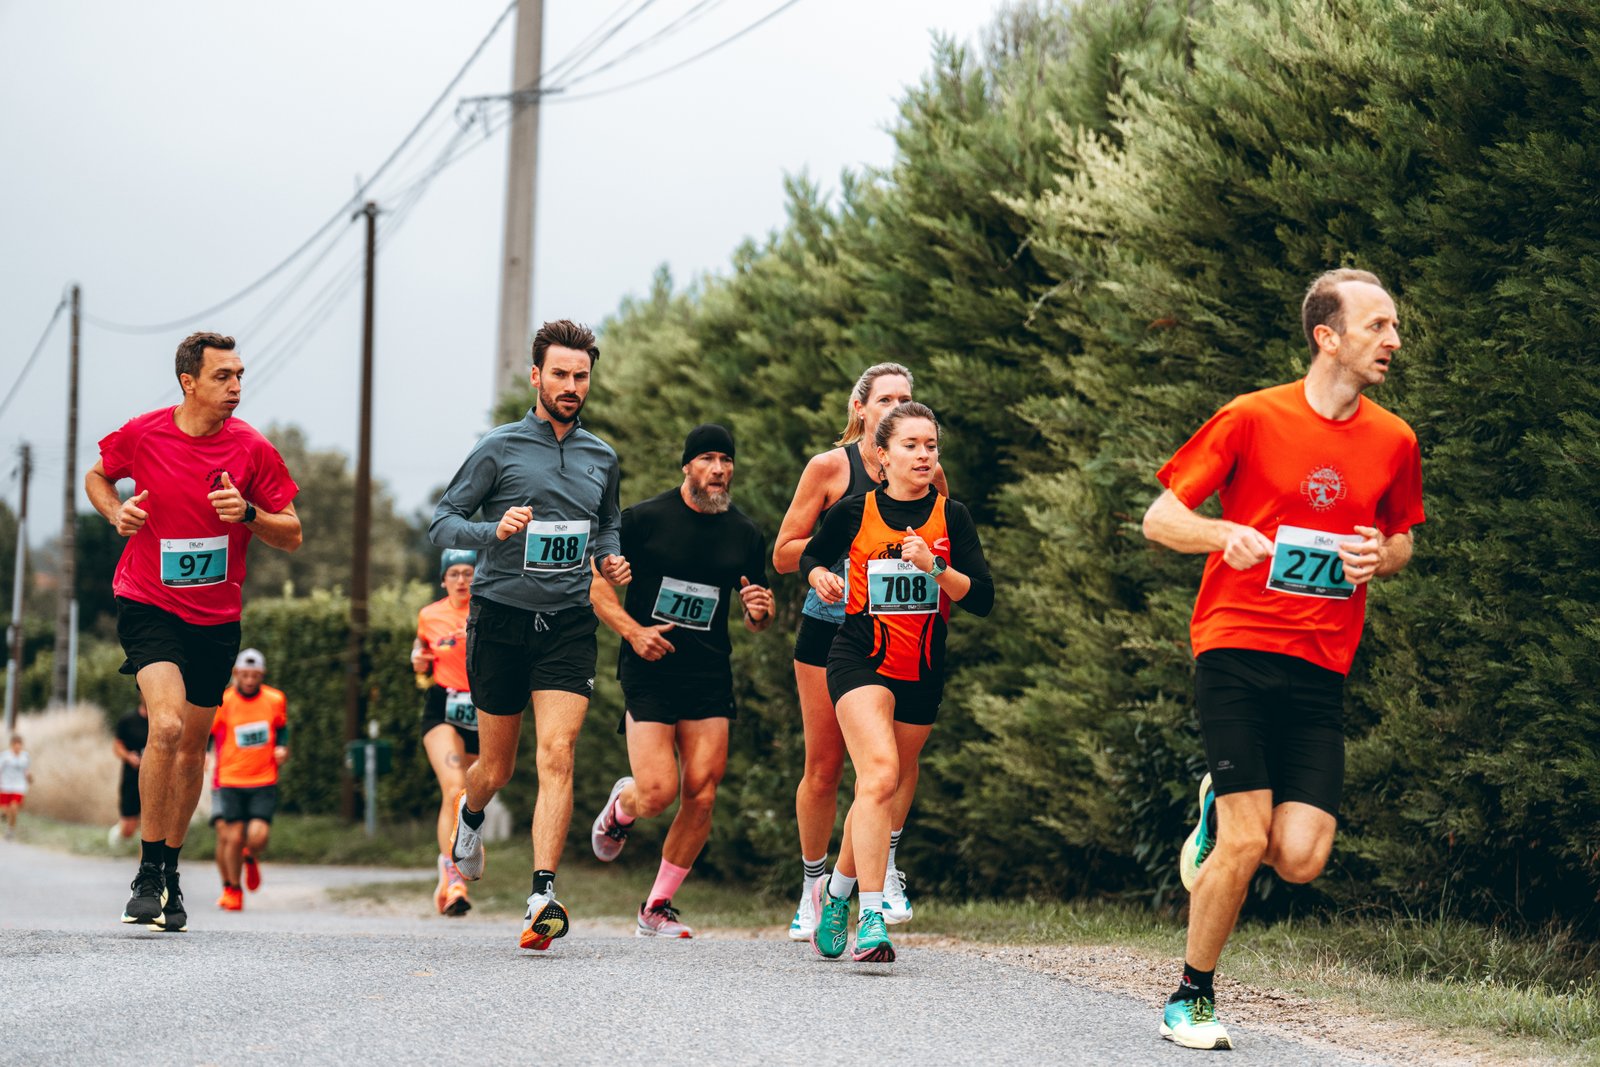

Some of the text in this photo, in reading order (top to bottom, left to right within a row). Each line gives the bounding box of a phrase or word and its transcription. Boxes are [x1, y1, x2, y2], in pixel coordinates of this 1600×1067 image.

[540, 536, 579, 562] 788
[179, 553, 213, 577] 97
[1282, 549, 1346, 585] 270
[882, 575, 927, 603] 708
[669, 593, 705, 620] 716
